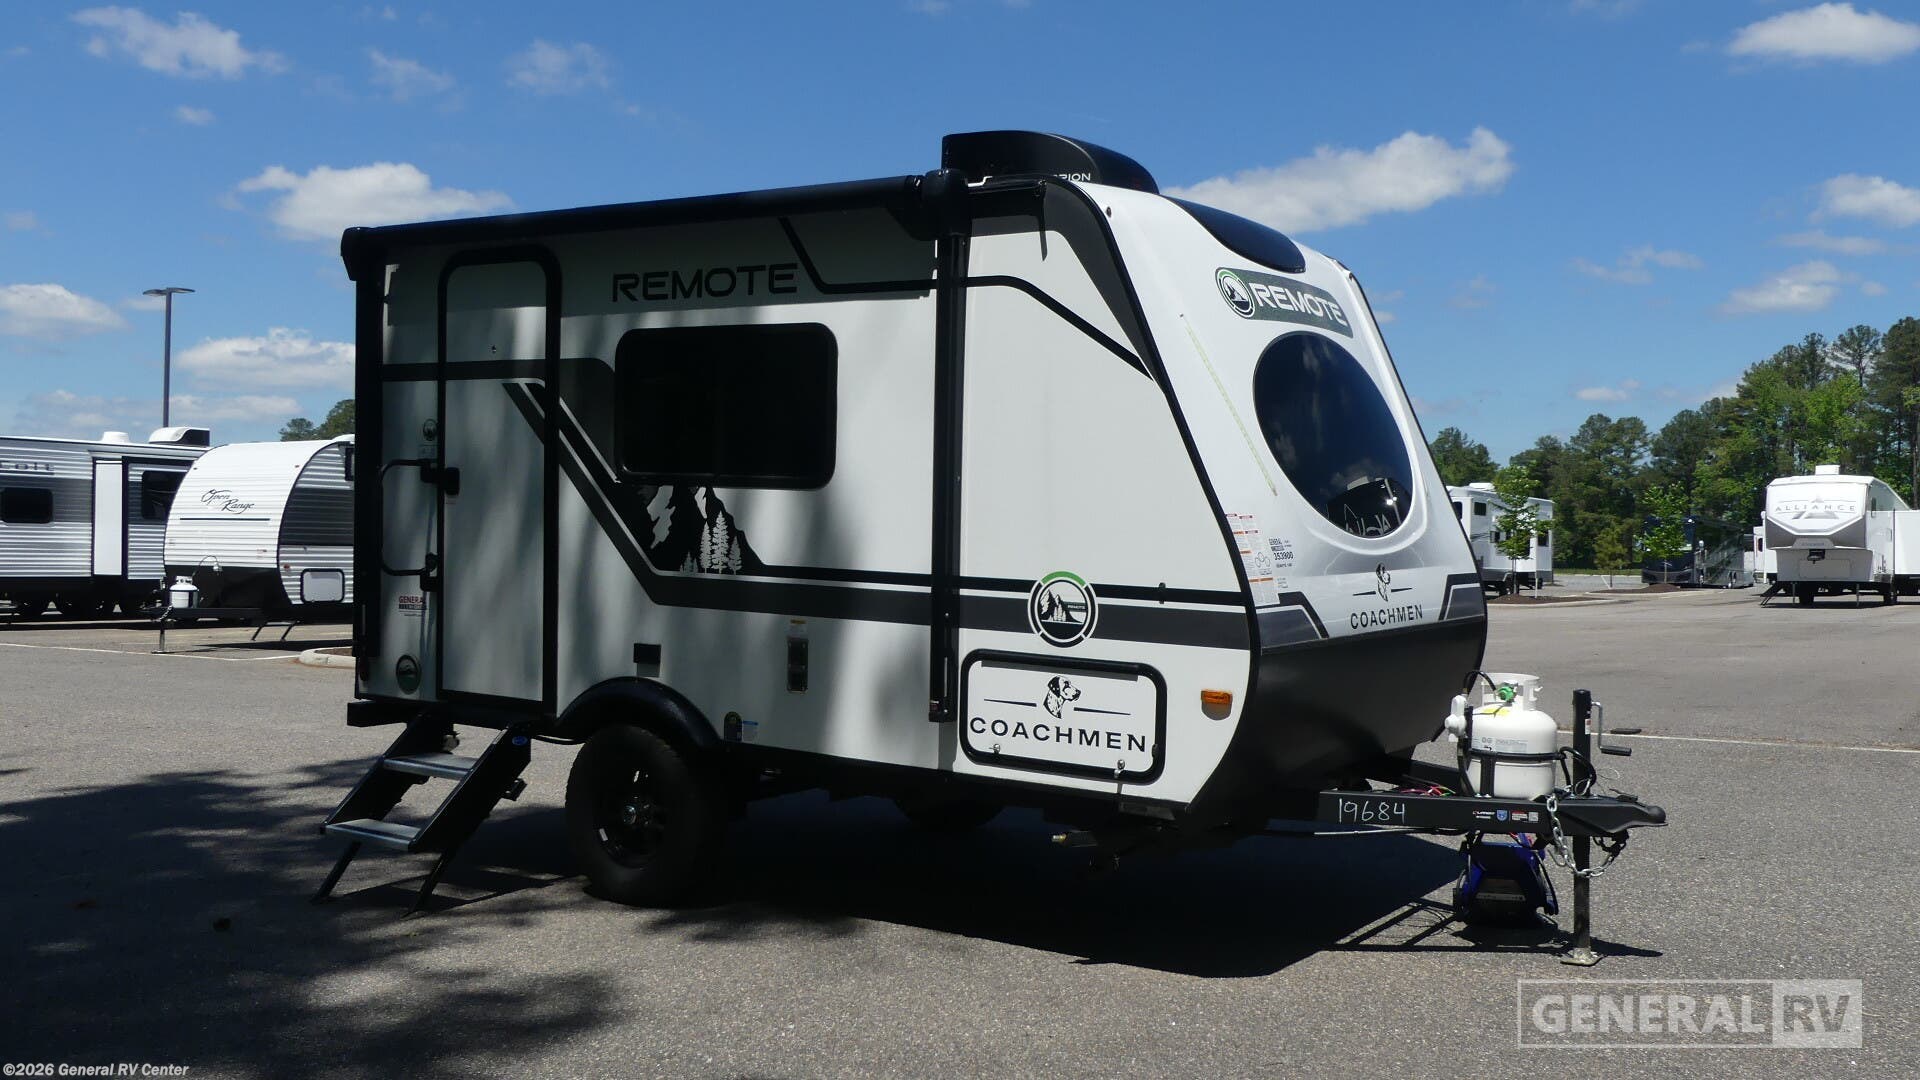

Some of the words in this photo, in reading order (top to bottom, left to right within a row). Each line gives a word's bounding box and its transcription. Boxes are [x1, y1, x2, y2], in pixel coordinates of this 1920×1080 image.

[612, 262, 798, 302] REMOTE
[1248, 282, 1349, 327] REMOTE
[200, 489, 232, 505] Open
[220, 498, 255, 514] Range
[1775, 504, 1855, 512] ALLIANCE
[1350, 604, 1423, 630] COACHMEN
[970, 717, 1146, 753] COACHMEN
[1337, 797, 1406, 824] 19684
